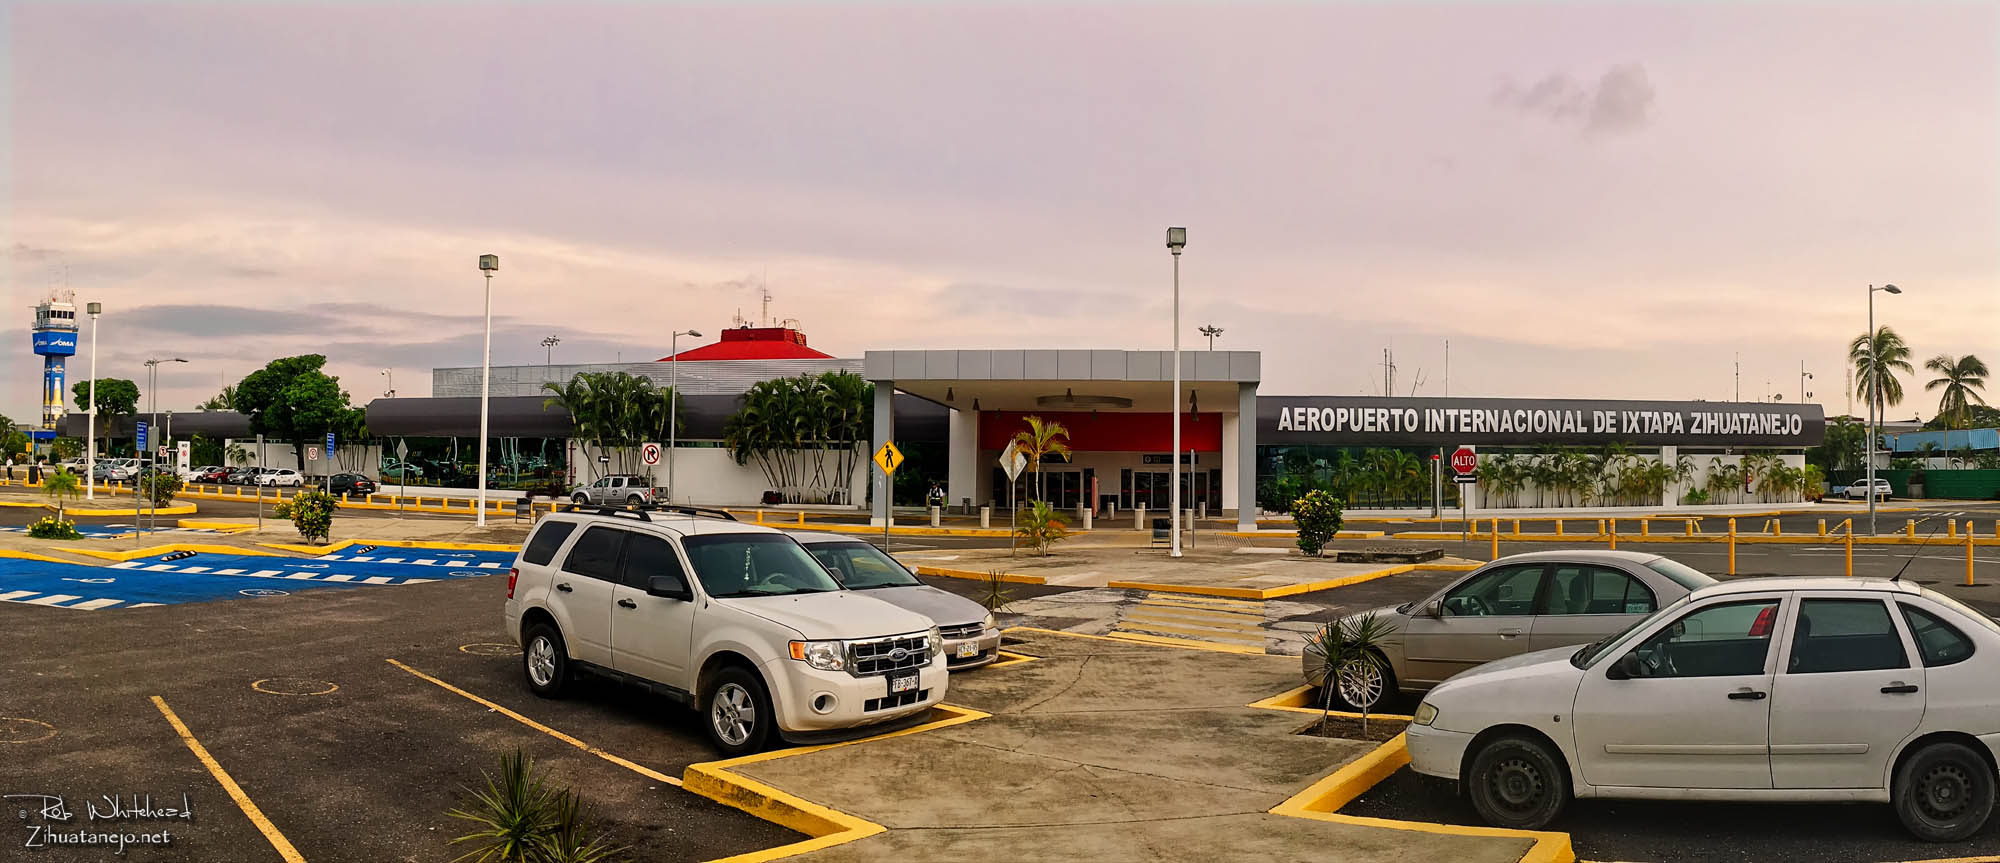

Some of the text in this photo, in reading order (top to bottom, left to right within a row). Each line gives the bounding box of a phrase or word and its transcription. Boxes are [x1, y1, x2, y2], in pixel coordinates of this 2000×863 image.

[1278, 407, 1803, 436] AEROPUERTO INTERNACIONAL DE IXTAPA ZIHUATANEJO
[1454, 455, 1475, 466] ALTO
